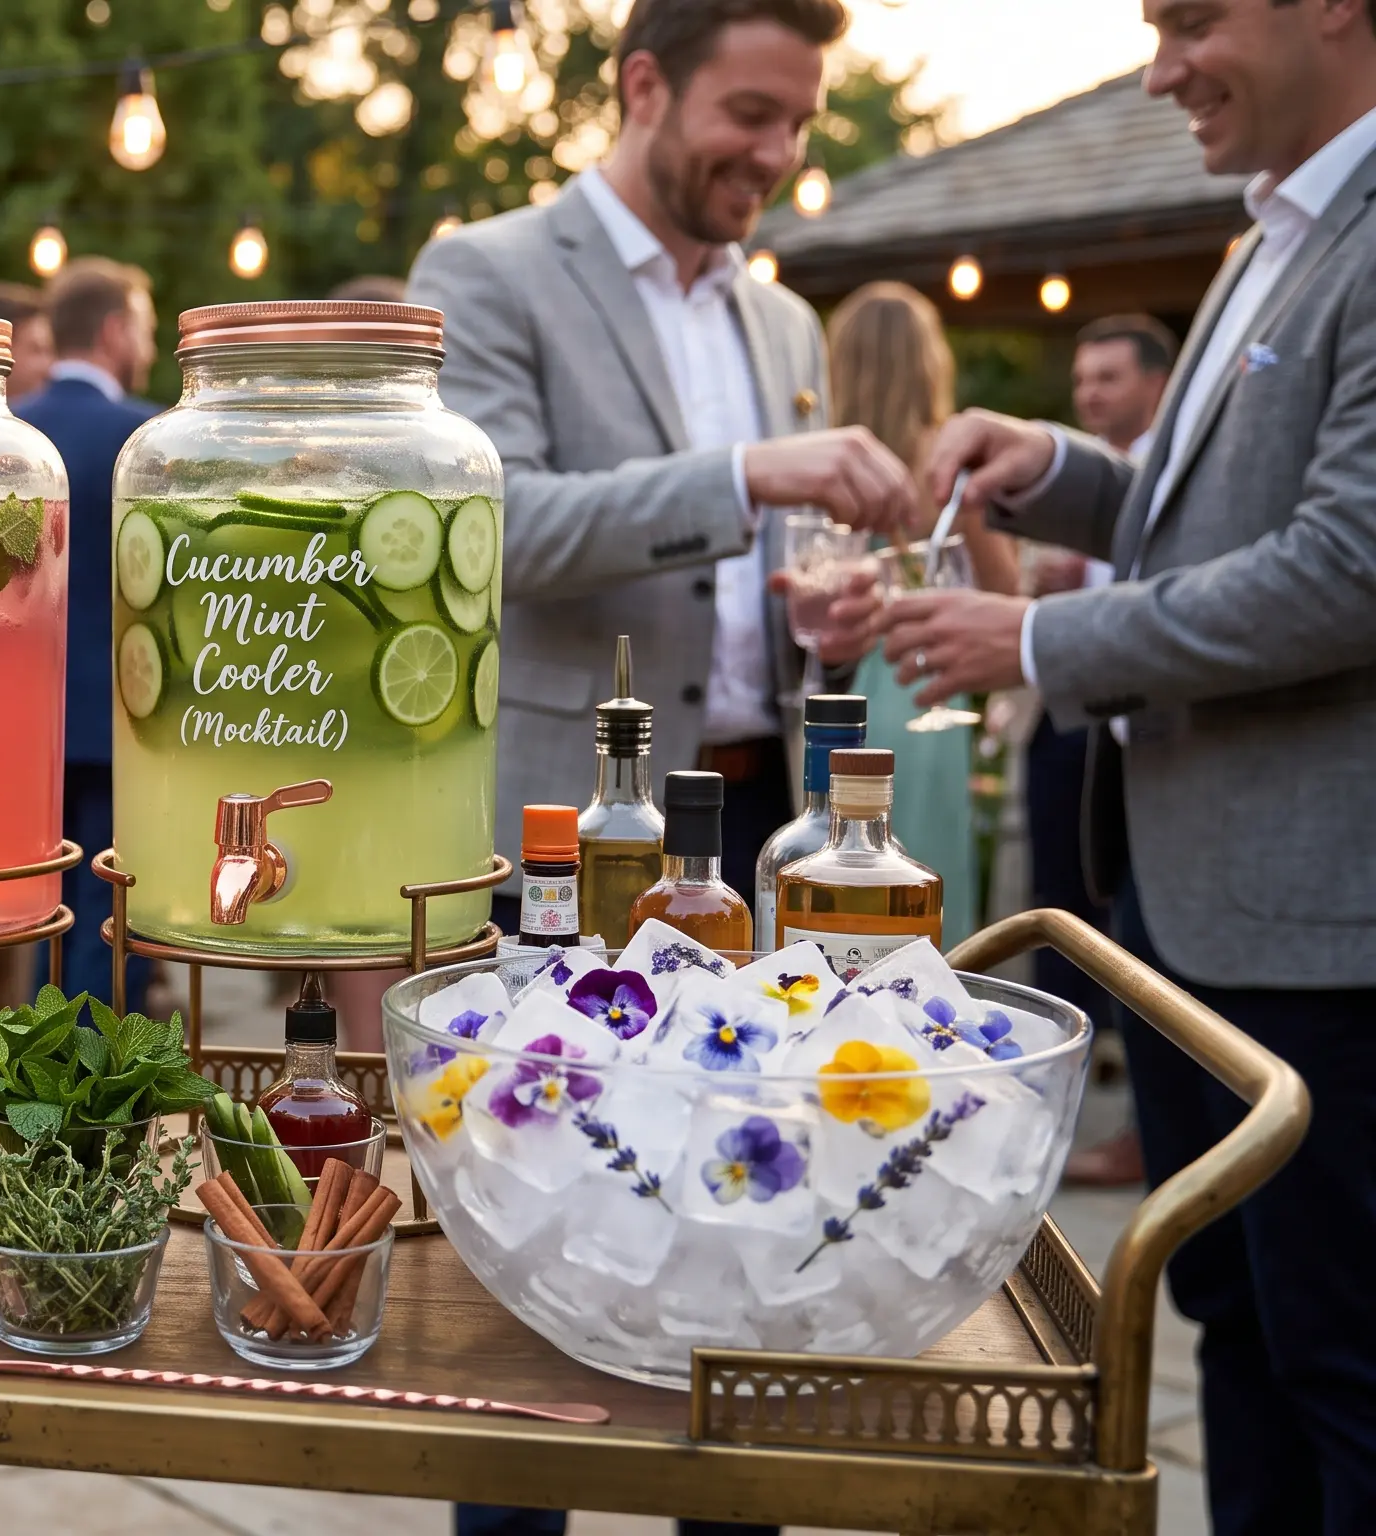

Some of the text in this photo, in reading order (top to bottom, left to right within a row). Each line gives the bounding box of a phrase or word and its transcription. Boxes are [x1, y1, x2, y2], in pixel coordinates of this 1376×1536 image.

[166, 533, 378, 587] Cucumber
[199, 592, 327, 645] Mint
[193, 642, 333, 696] Cooler
[180, 705, 349, 751] (Mocktail)
